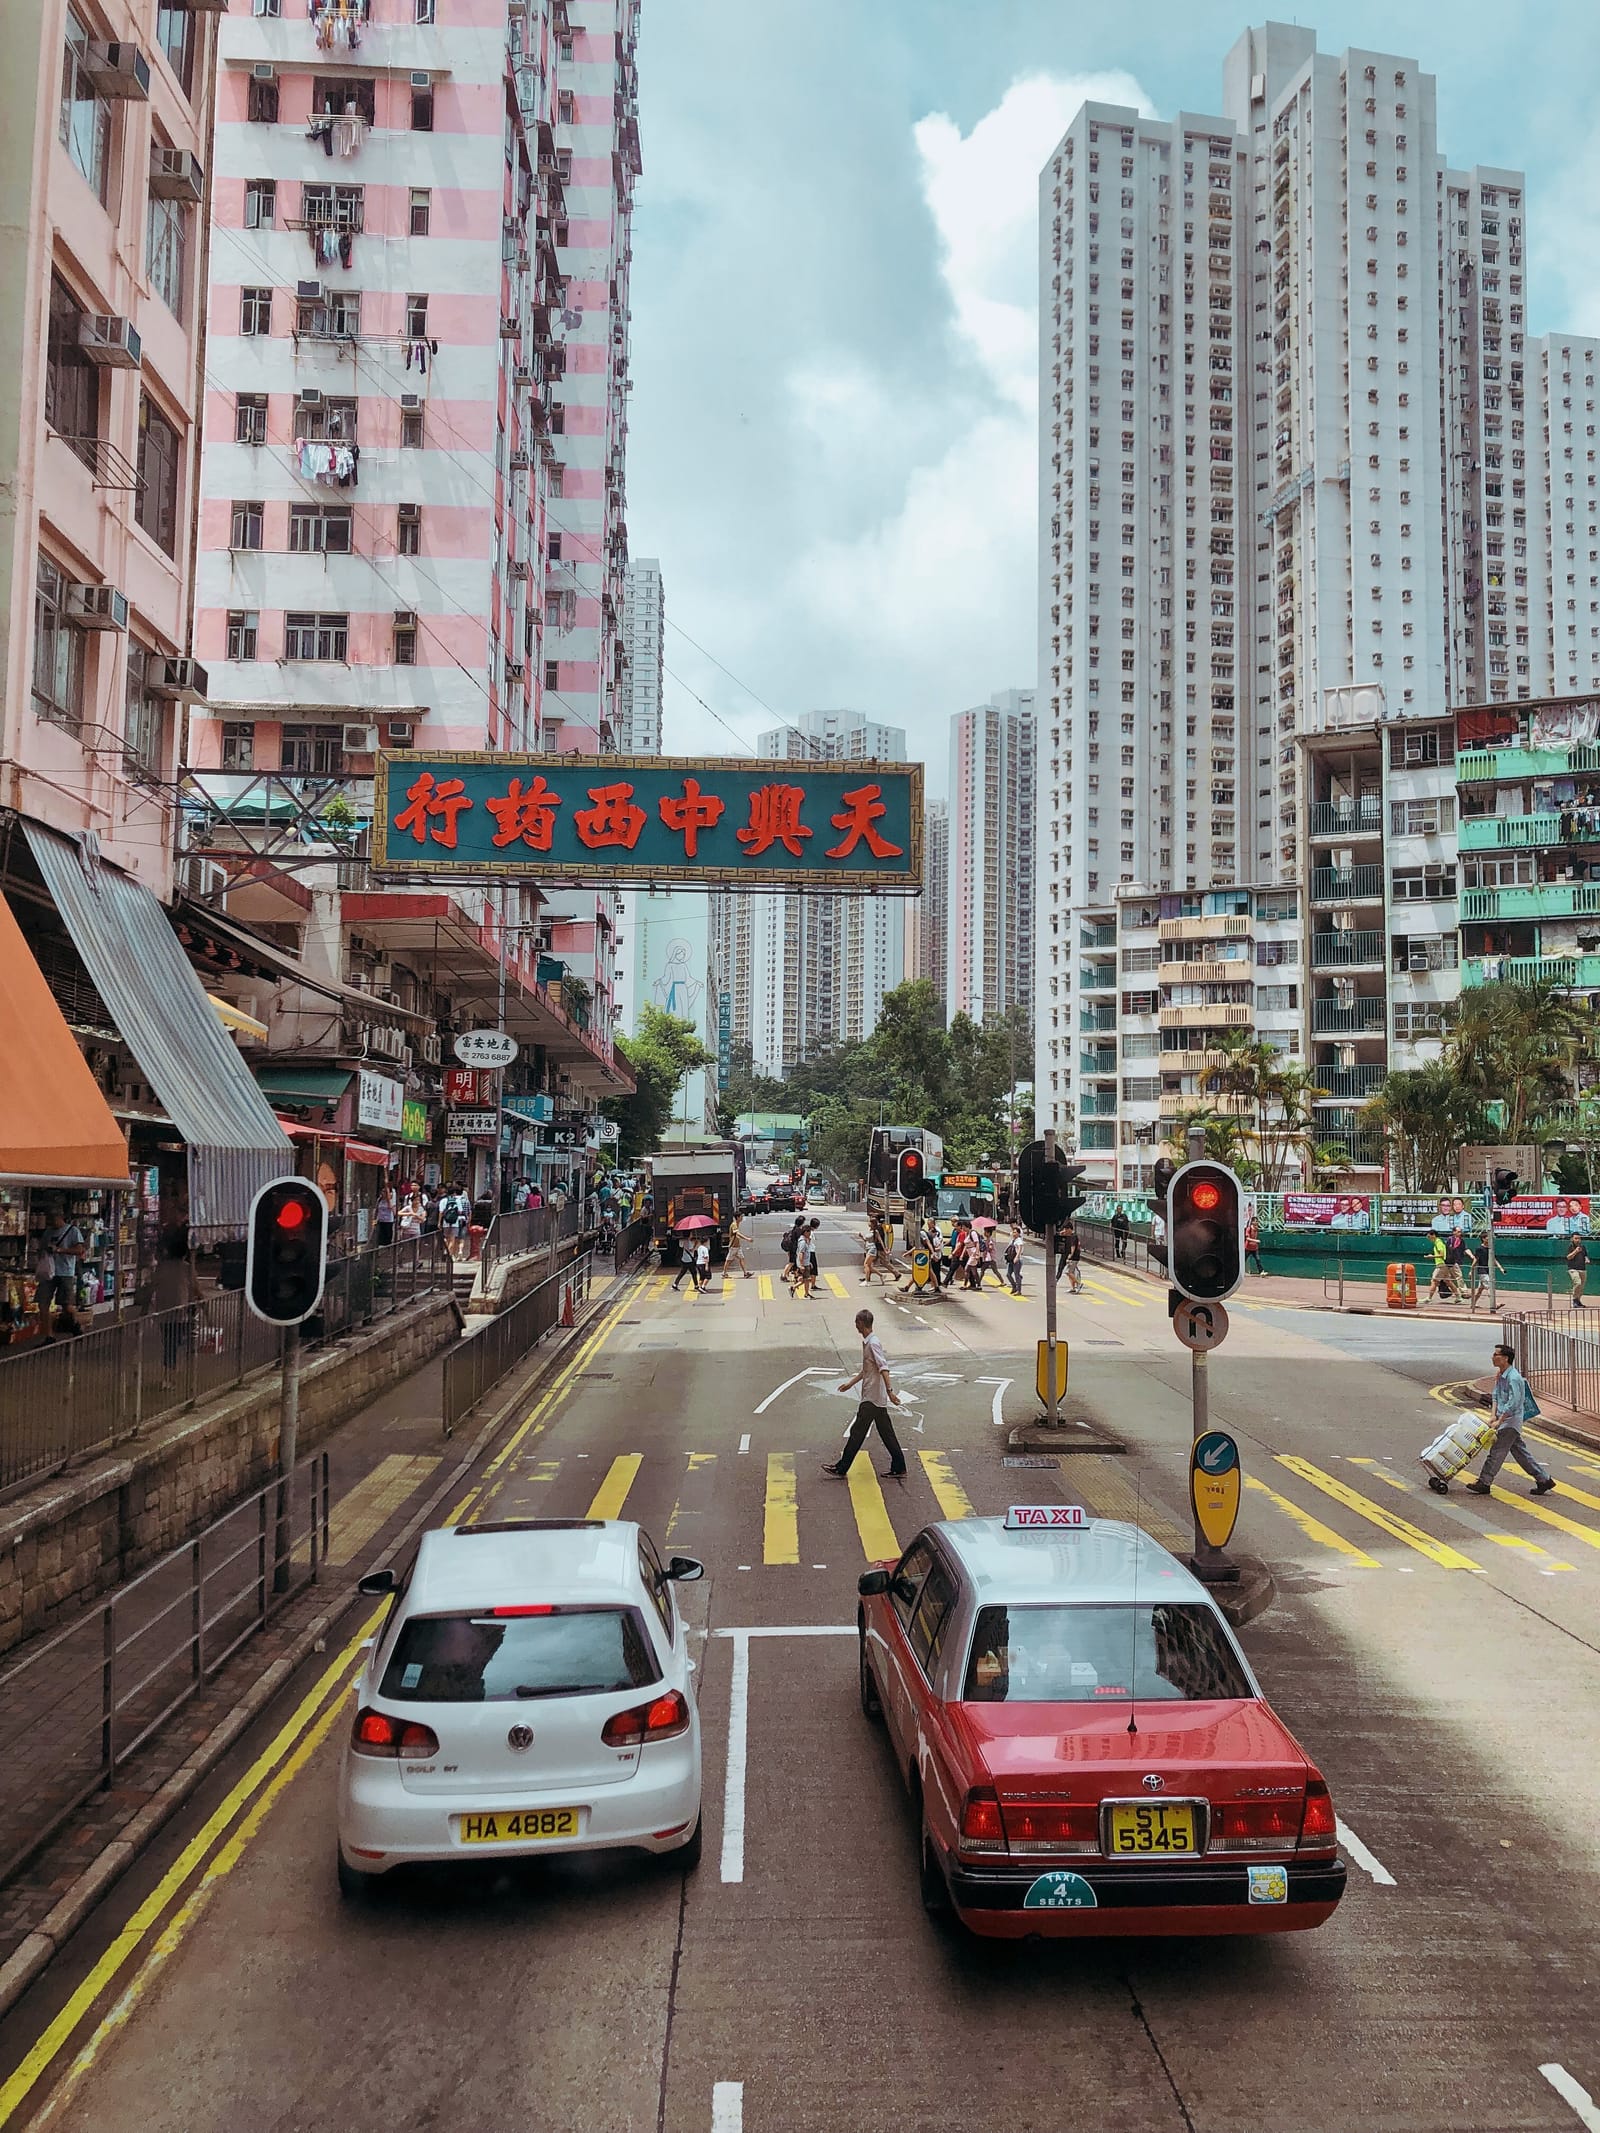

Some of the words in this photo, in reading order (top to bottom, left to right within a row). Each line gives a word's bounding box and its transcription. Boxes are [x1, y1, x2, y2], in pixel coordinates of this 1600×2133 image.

[462, 1036, 512, 1051] 富安地產
[471, 1052, 490, 1060] 2763
[455, 1071, 473, 1089] 明
[554, 1132, 576, 1144] K2
[1014, 1509, 1082, 1524] TAXI
[406, 1766, 436, 1774] GOLF
[1136, 1806, 1169, 1829] ST
[466, 1816, 498, 1839] HA
[507, 1812, 573, 1837] 4882
[1119, 1827, 1188, 1851] 5345
[1046, 1873, 1076, 1884] TAXI
[1053, 1882, 1068, 1898] 4
[1039, 1898, 1082, 1906] SEATS
